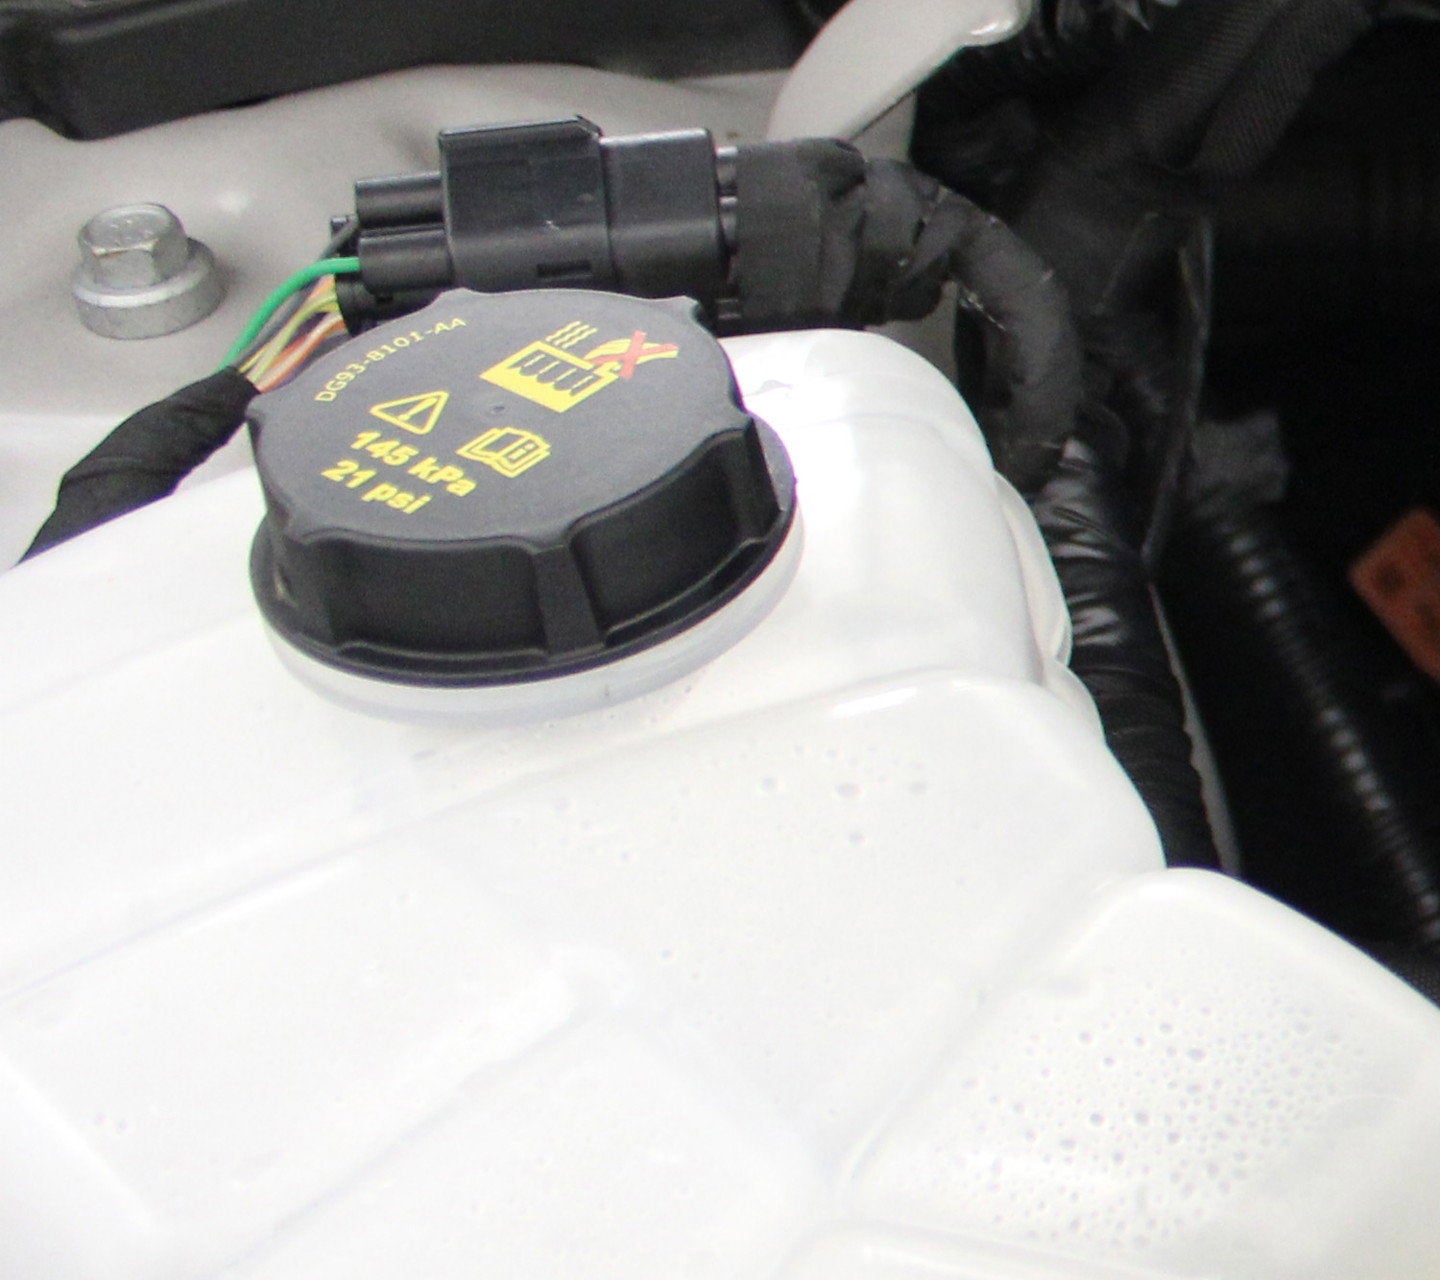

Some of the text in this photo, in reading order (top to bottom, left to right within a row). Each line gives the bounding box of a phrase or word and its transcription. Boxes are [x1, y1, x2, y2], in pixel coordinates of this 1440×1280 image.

[321, 459, 432, 515] 21 psi
[350, 430, 477, 497] 145 kPa
